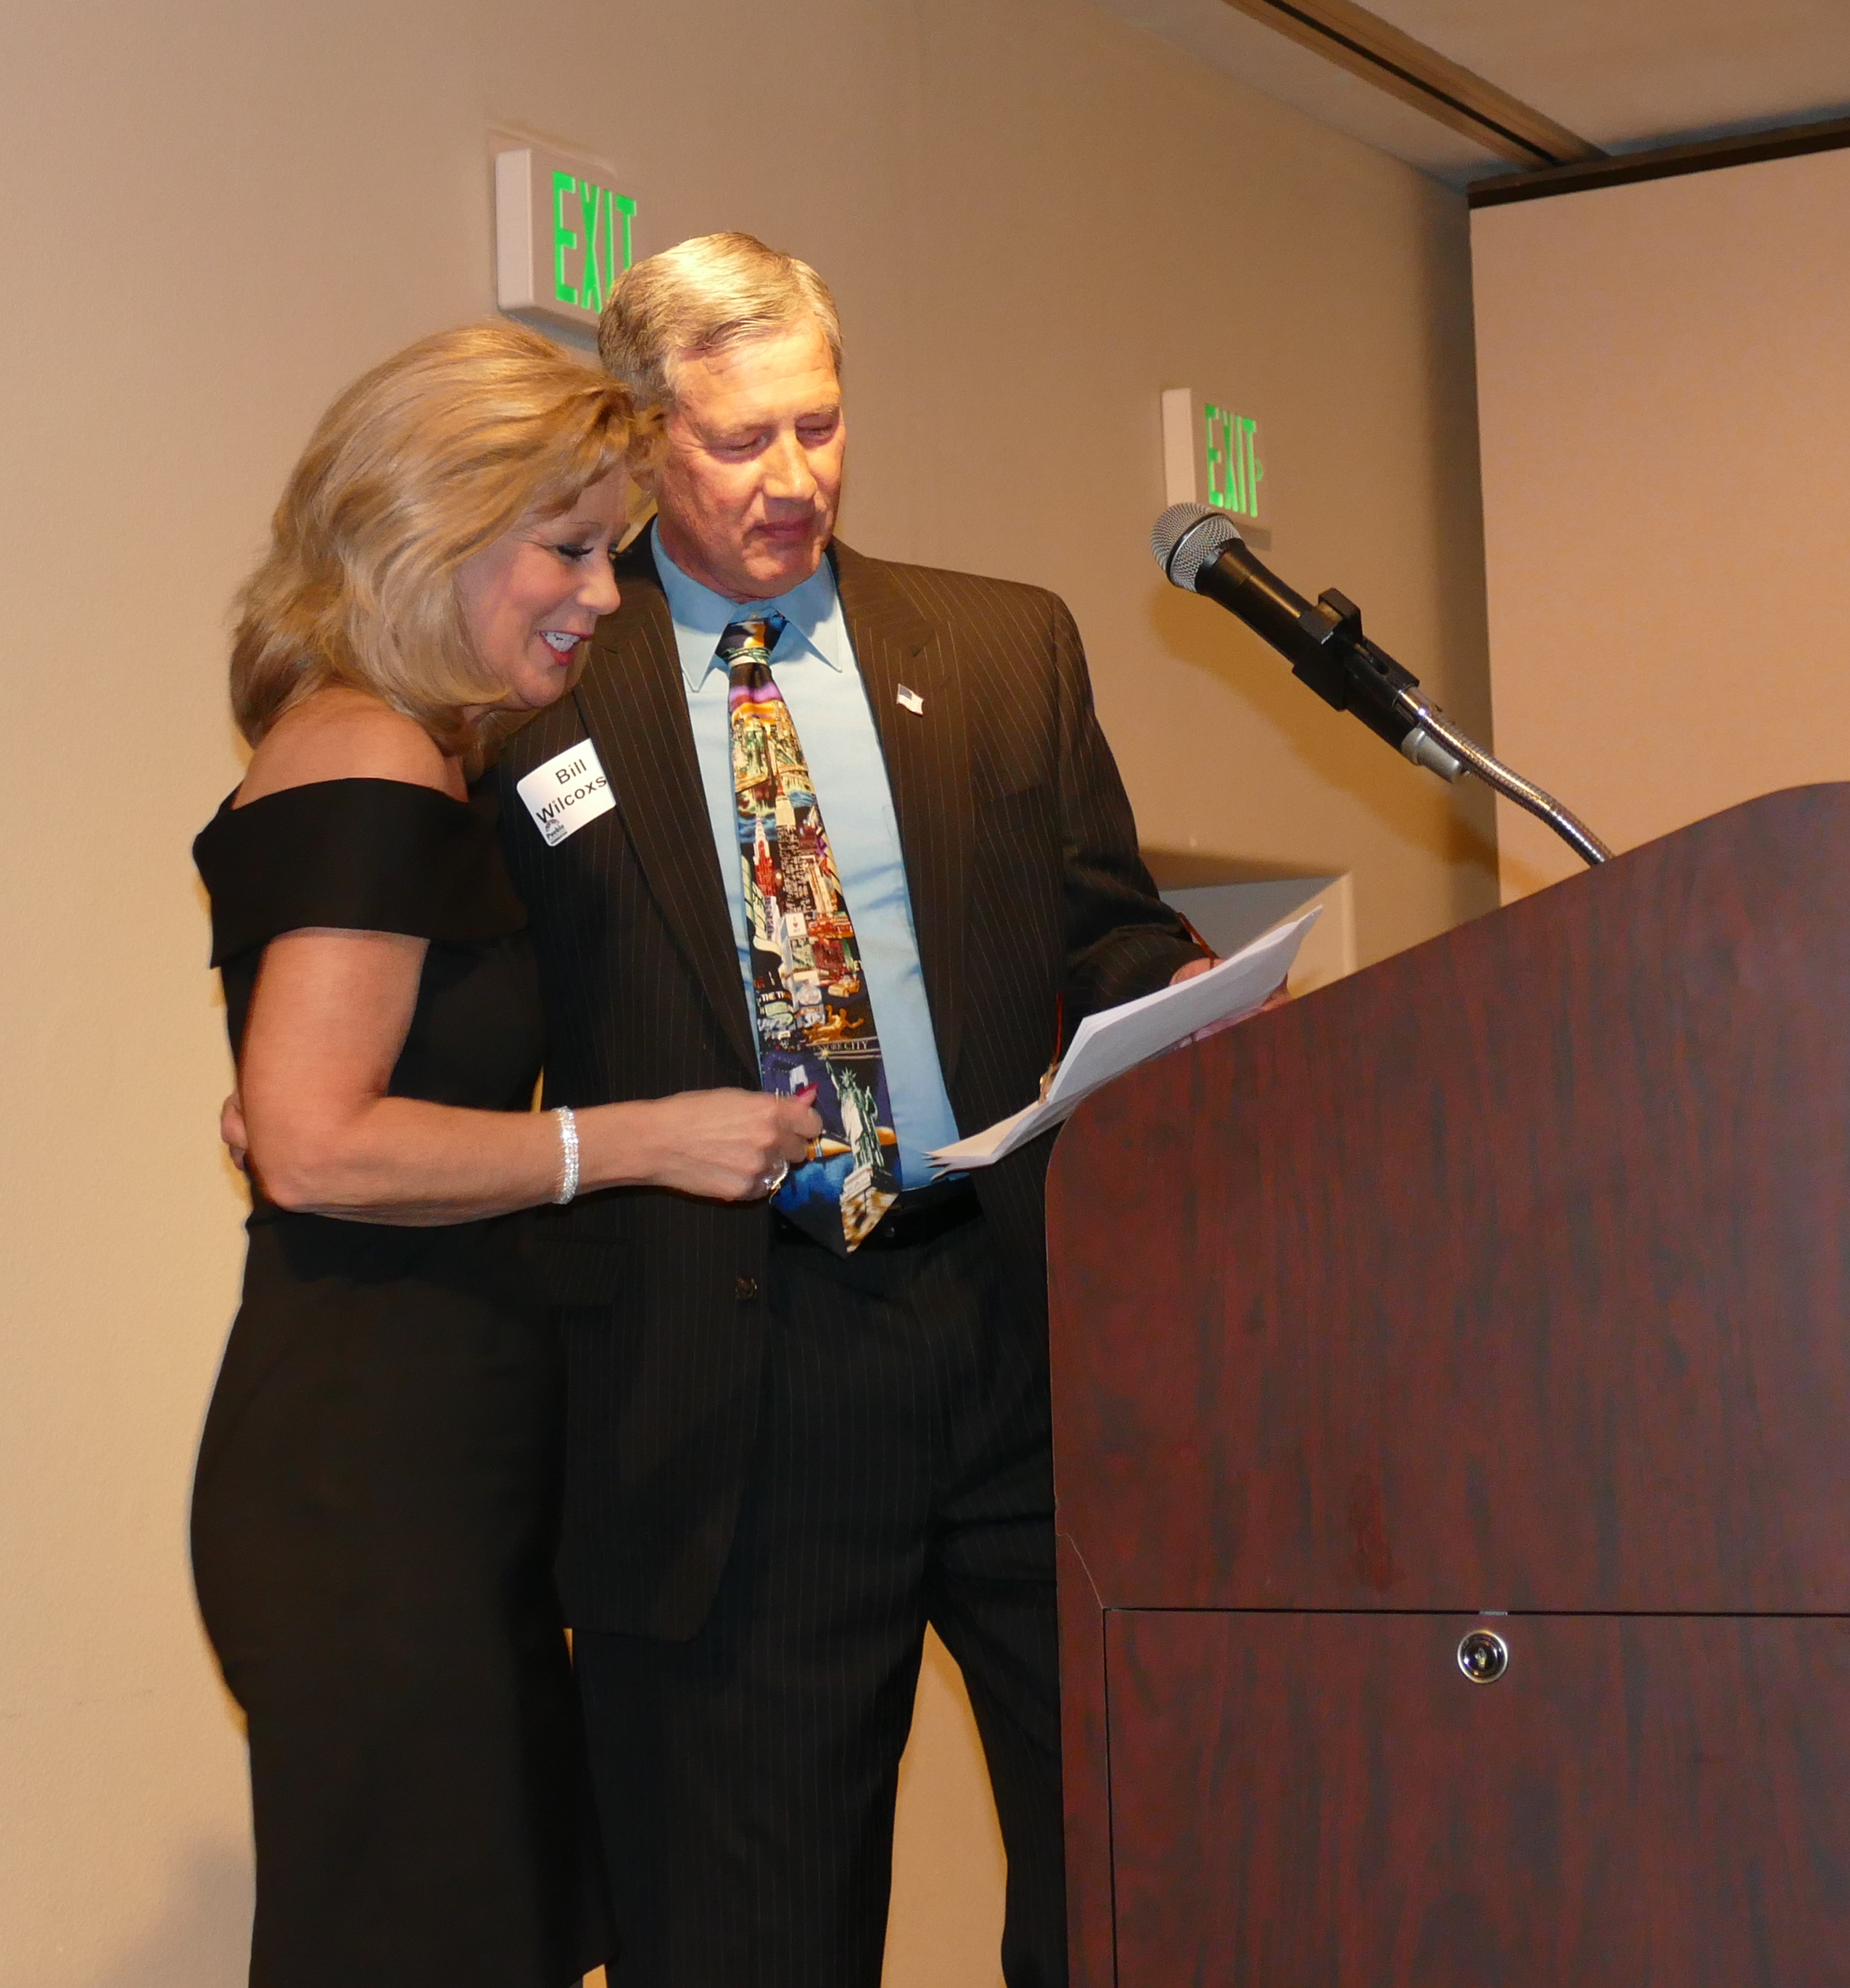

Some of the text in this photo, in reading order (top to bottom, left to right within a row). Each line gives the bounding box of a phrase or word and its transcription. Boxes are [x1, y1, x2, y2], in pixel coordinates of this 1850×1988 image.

[553, 170, 637, 313] EXIT
[1205, 403, 1258, 518] EXIT
[556, 759, 587, 784] Bill
[536, 776, 607, 824] Wilcoxs
[844, 1040, 868, 1051] CITY
